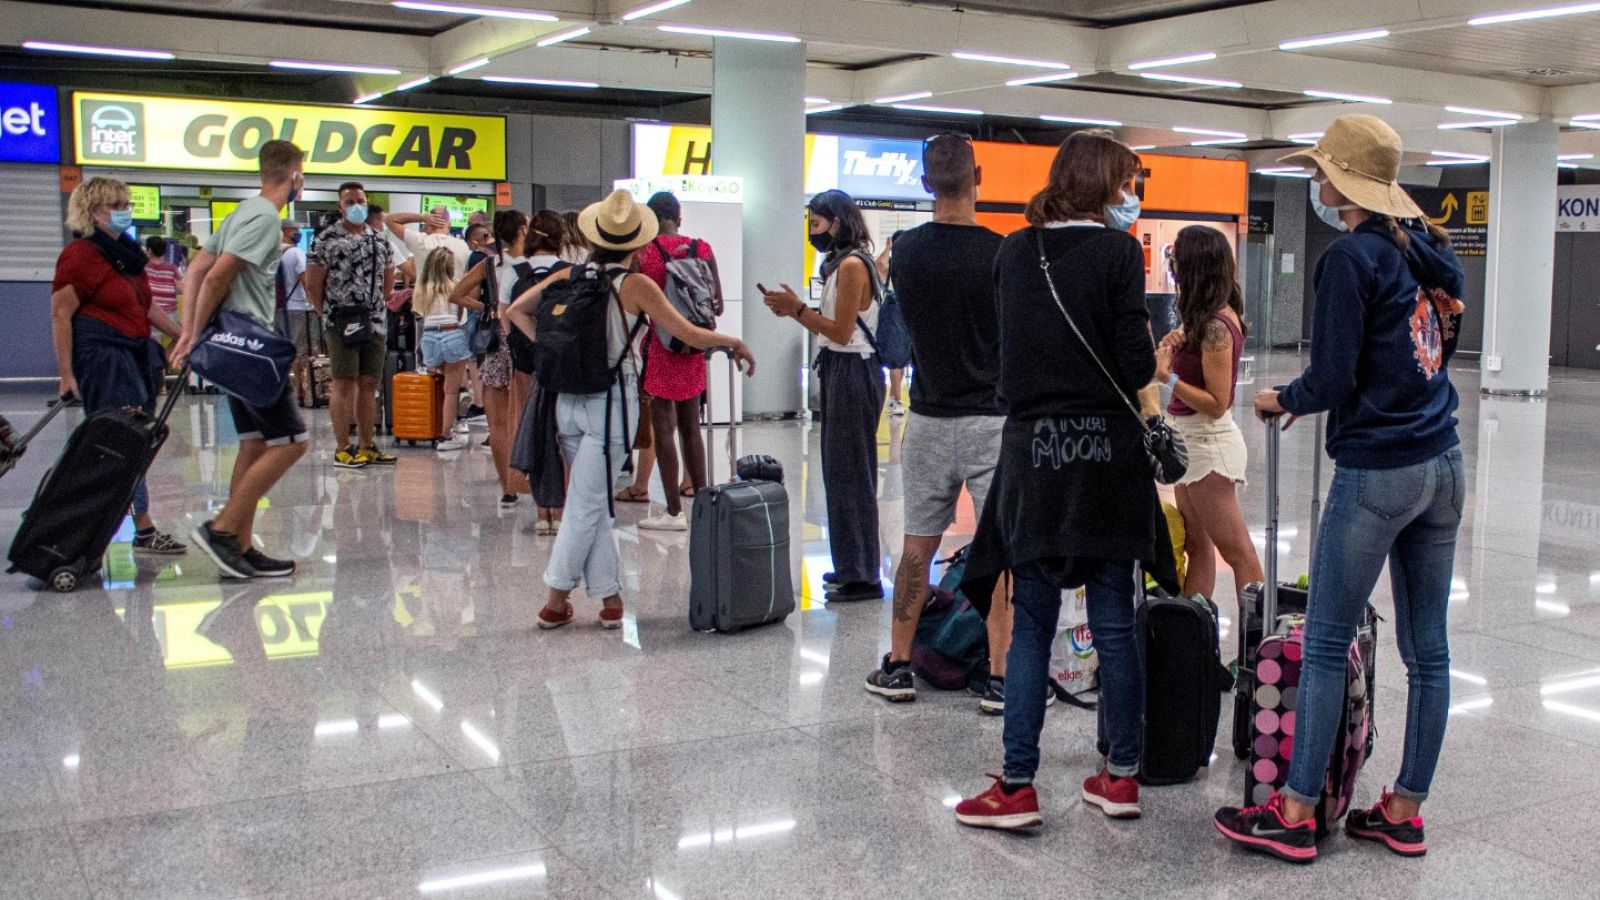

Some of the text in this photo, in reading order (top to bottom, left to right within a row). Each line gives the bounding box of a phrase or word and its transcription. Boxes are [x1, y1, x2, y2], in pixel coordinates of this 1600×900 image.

[0, 102, 46, 137] et
[91, 126, 136, 142] inter
[91, 141, 136, 155] rent
[183, 114, 477, 170] GOLDCAR
[843, 150, 918, 183] Thrifty
[1558, 198, 1599, 217] KON
[1032, 432, 1112, 469] MOON
